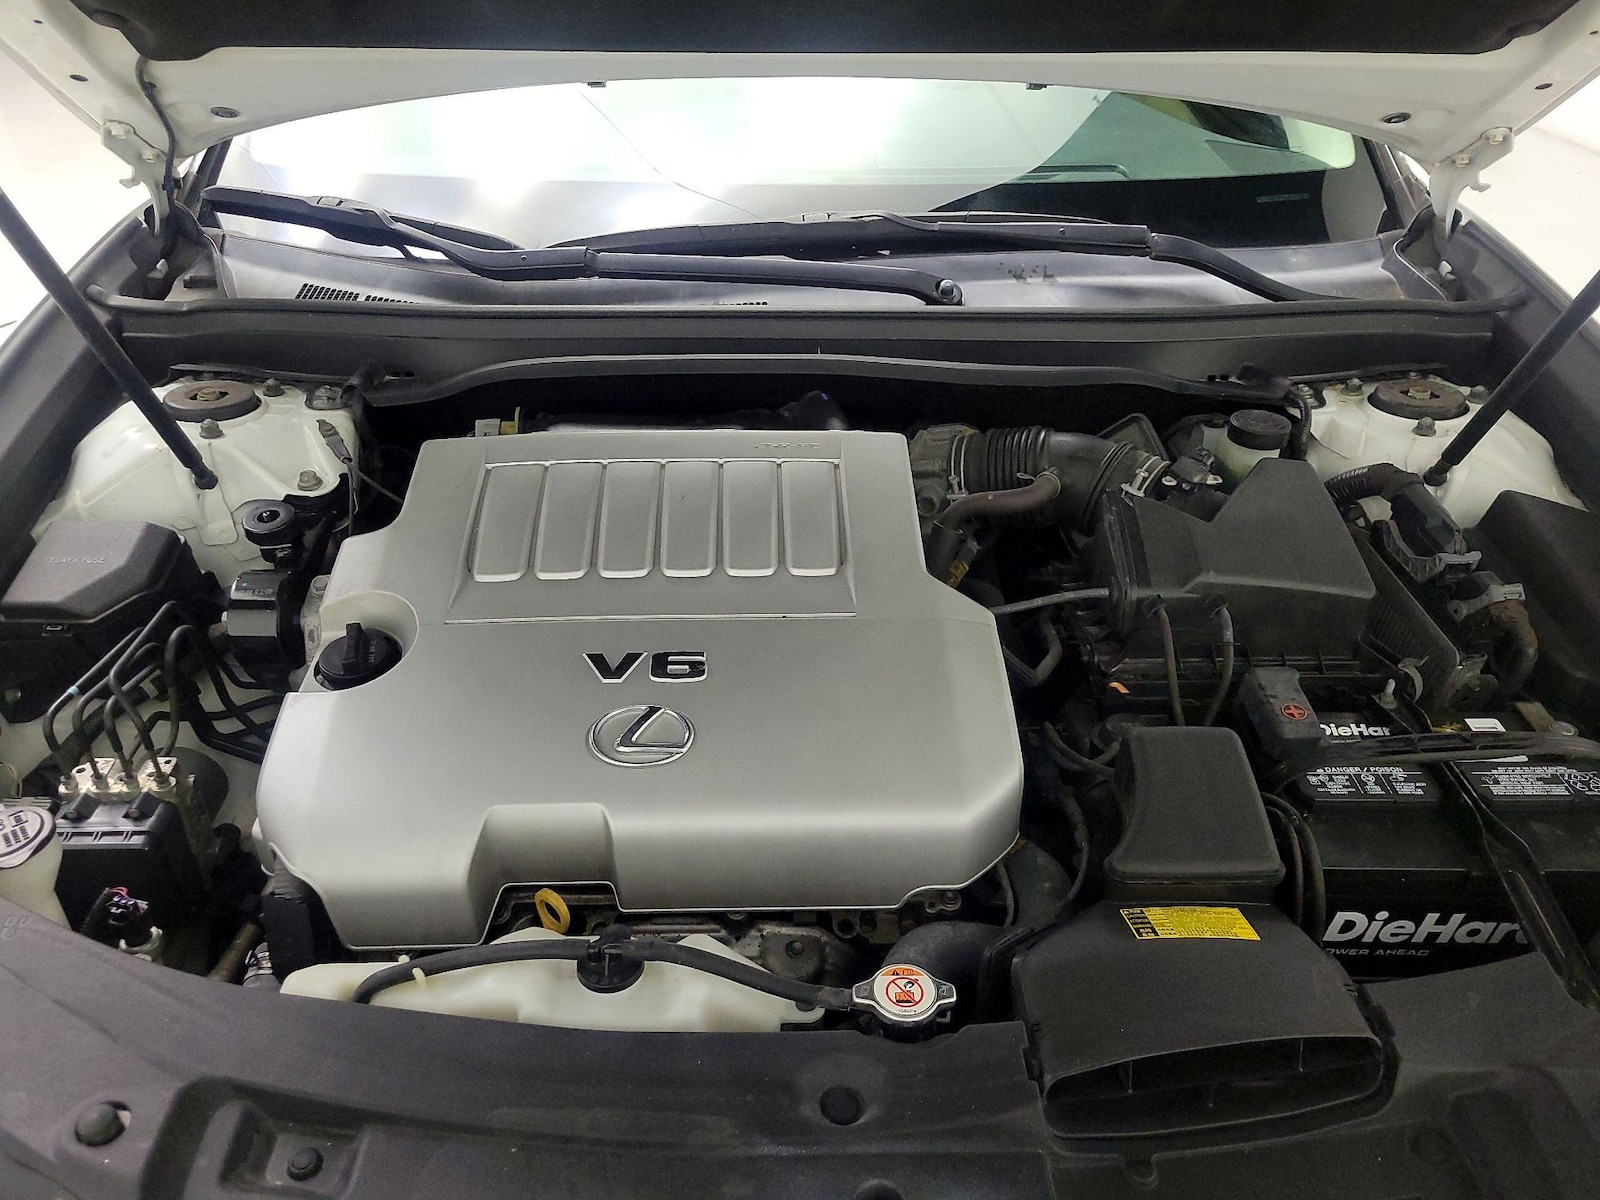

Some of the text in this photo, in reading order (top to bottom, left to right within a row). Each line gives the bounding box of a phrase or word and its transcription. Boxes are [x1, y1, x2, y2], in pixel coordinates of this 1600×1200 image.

[582, 651, 708, 683] V6
[1324, 766, 1362, 774] DANGER
[1369, 766, 1404, 774] POISON
[1322, 911, 1529, 944] DieHar
[1372, 949, 1430, 957] AHEAD
